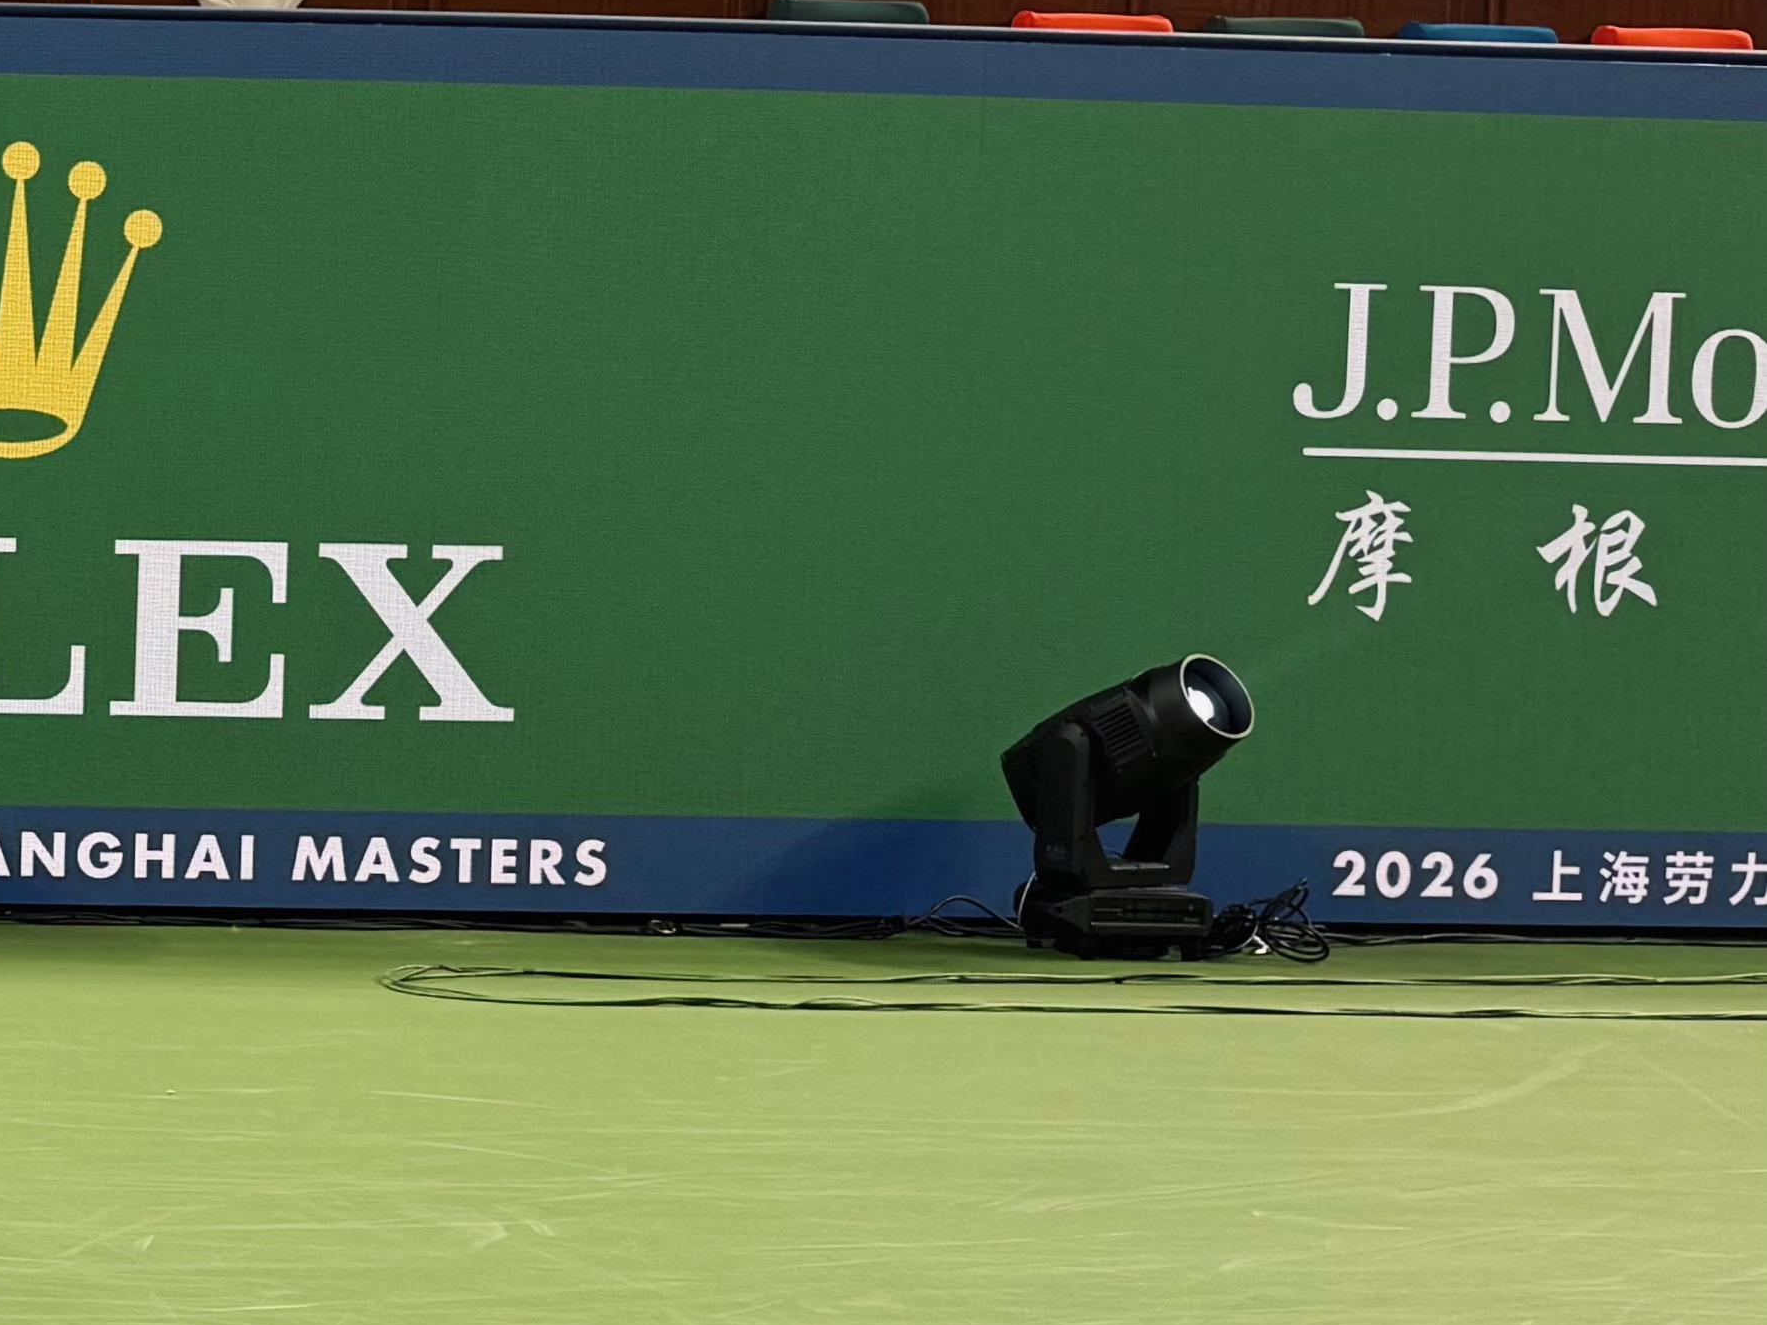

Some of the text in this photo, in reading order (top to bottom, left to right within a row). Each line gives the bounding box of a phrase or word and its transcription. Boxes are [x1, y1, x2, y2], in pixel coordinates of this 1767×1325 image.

[1307, 489, 1658, 622] 摩根
[291, 834, 607, 886] MASTERS
[1332, 849, 1499, 900] 2026
